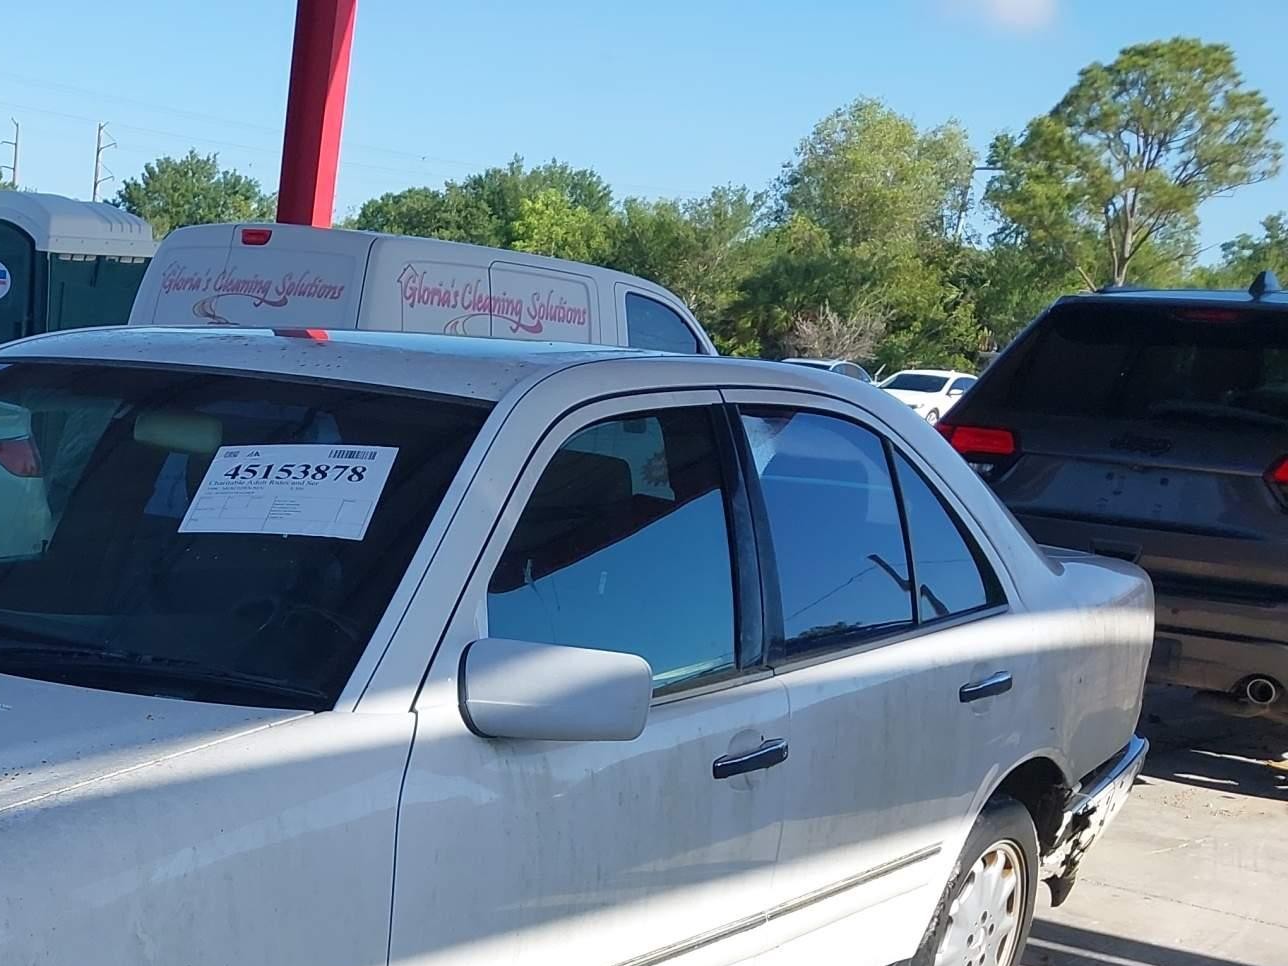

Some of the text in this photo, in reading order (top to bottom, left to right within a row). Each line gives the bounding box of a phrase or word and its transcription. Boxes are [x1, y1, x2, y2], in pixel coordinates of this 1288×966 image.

[163, 265, 344, 300] Gloria's Cleaning Solutions
[403, 272, 587, 326] Gloria's Cleaning Solutions
[224, 463, 367, 483] 45153878
